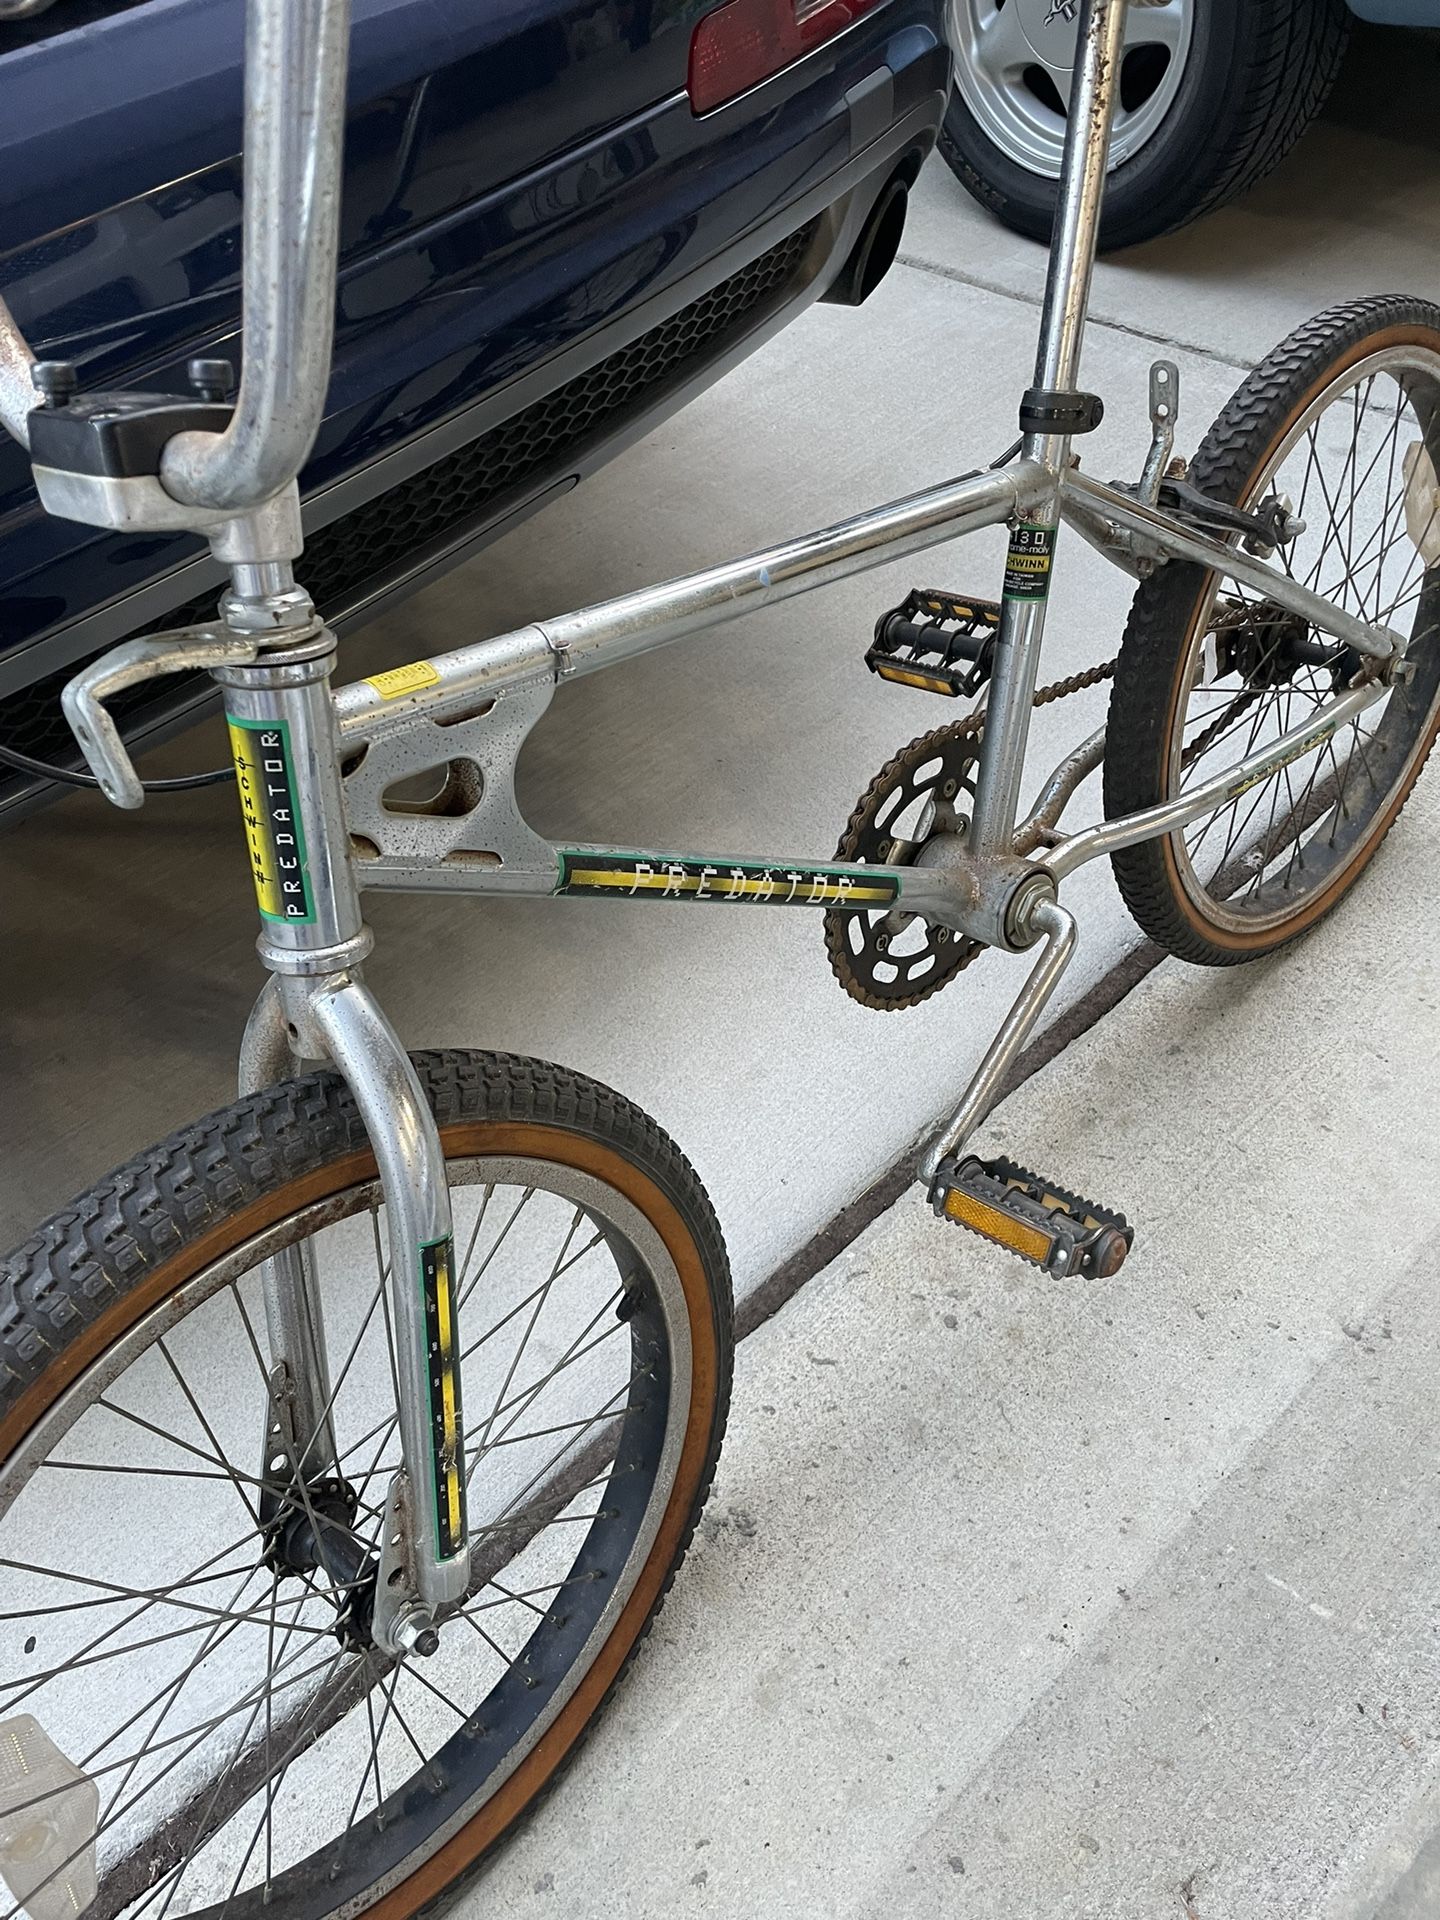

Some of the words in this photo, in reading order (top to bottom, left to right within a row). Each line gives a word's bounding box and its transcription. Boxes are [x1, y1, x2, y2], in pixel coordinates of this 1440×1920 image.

[1010, 530, 1045, 544] 130
[237, 755, 266, 885] SCHWINN
[260, 730, 306, 916] PREDATOR
[629, 861, 856, 905] PREDATOR
